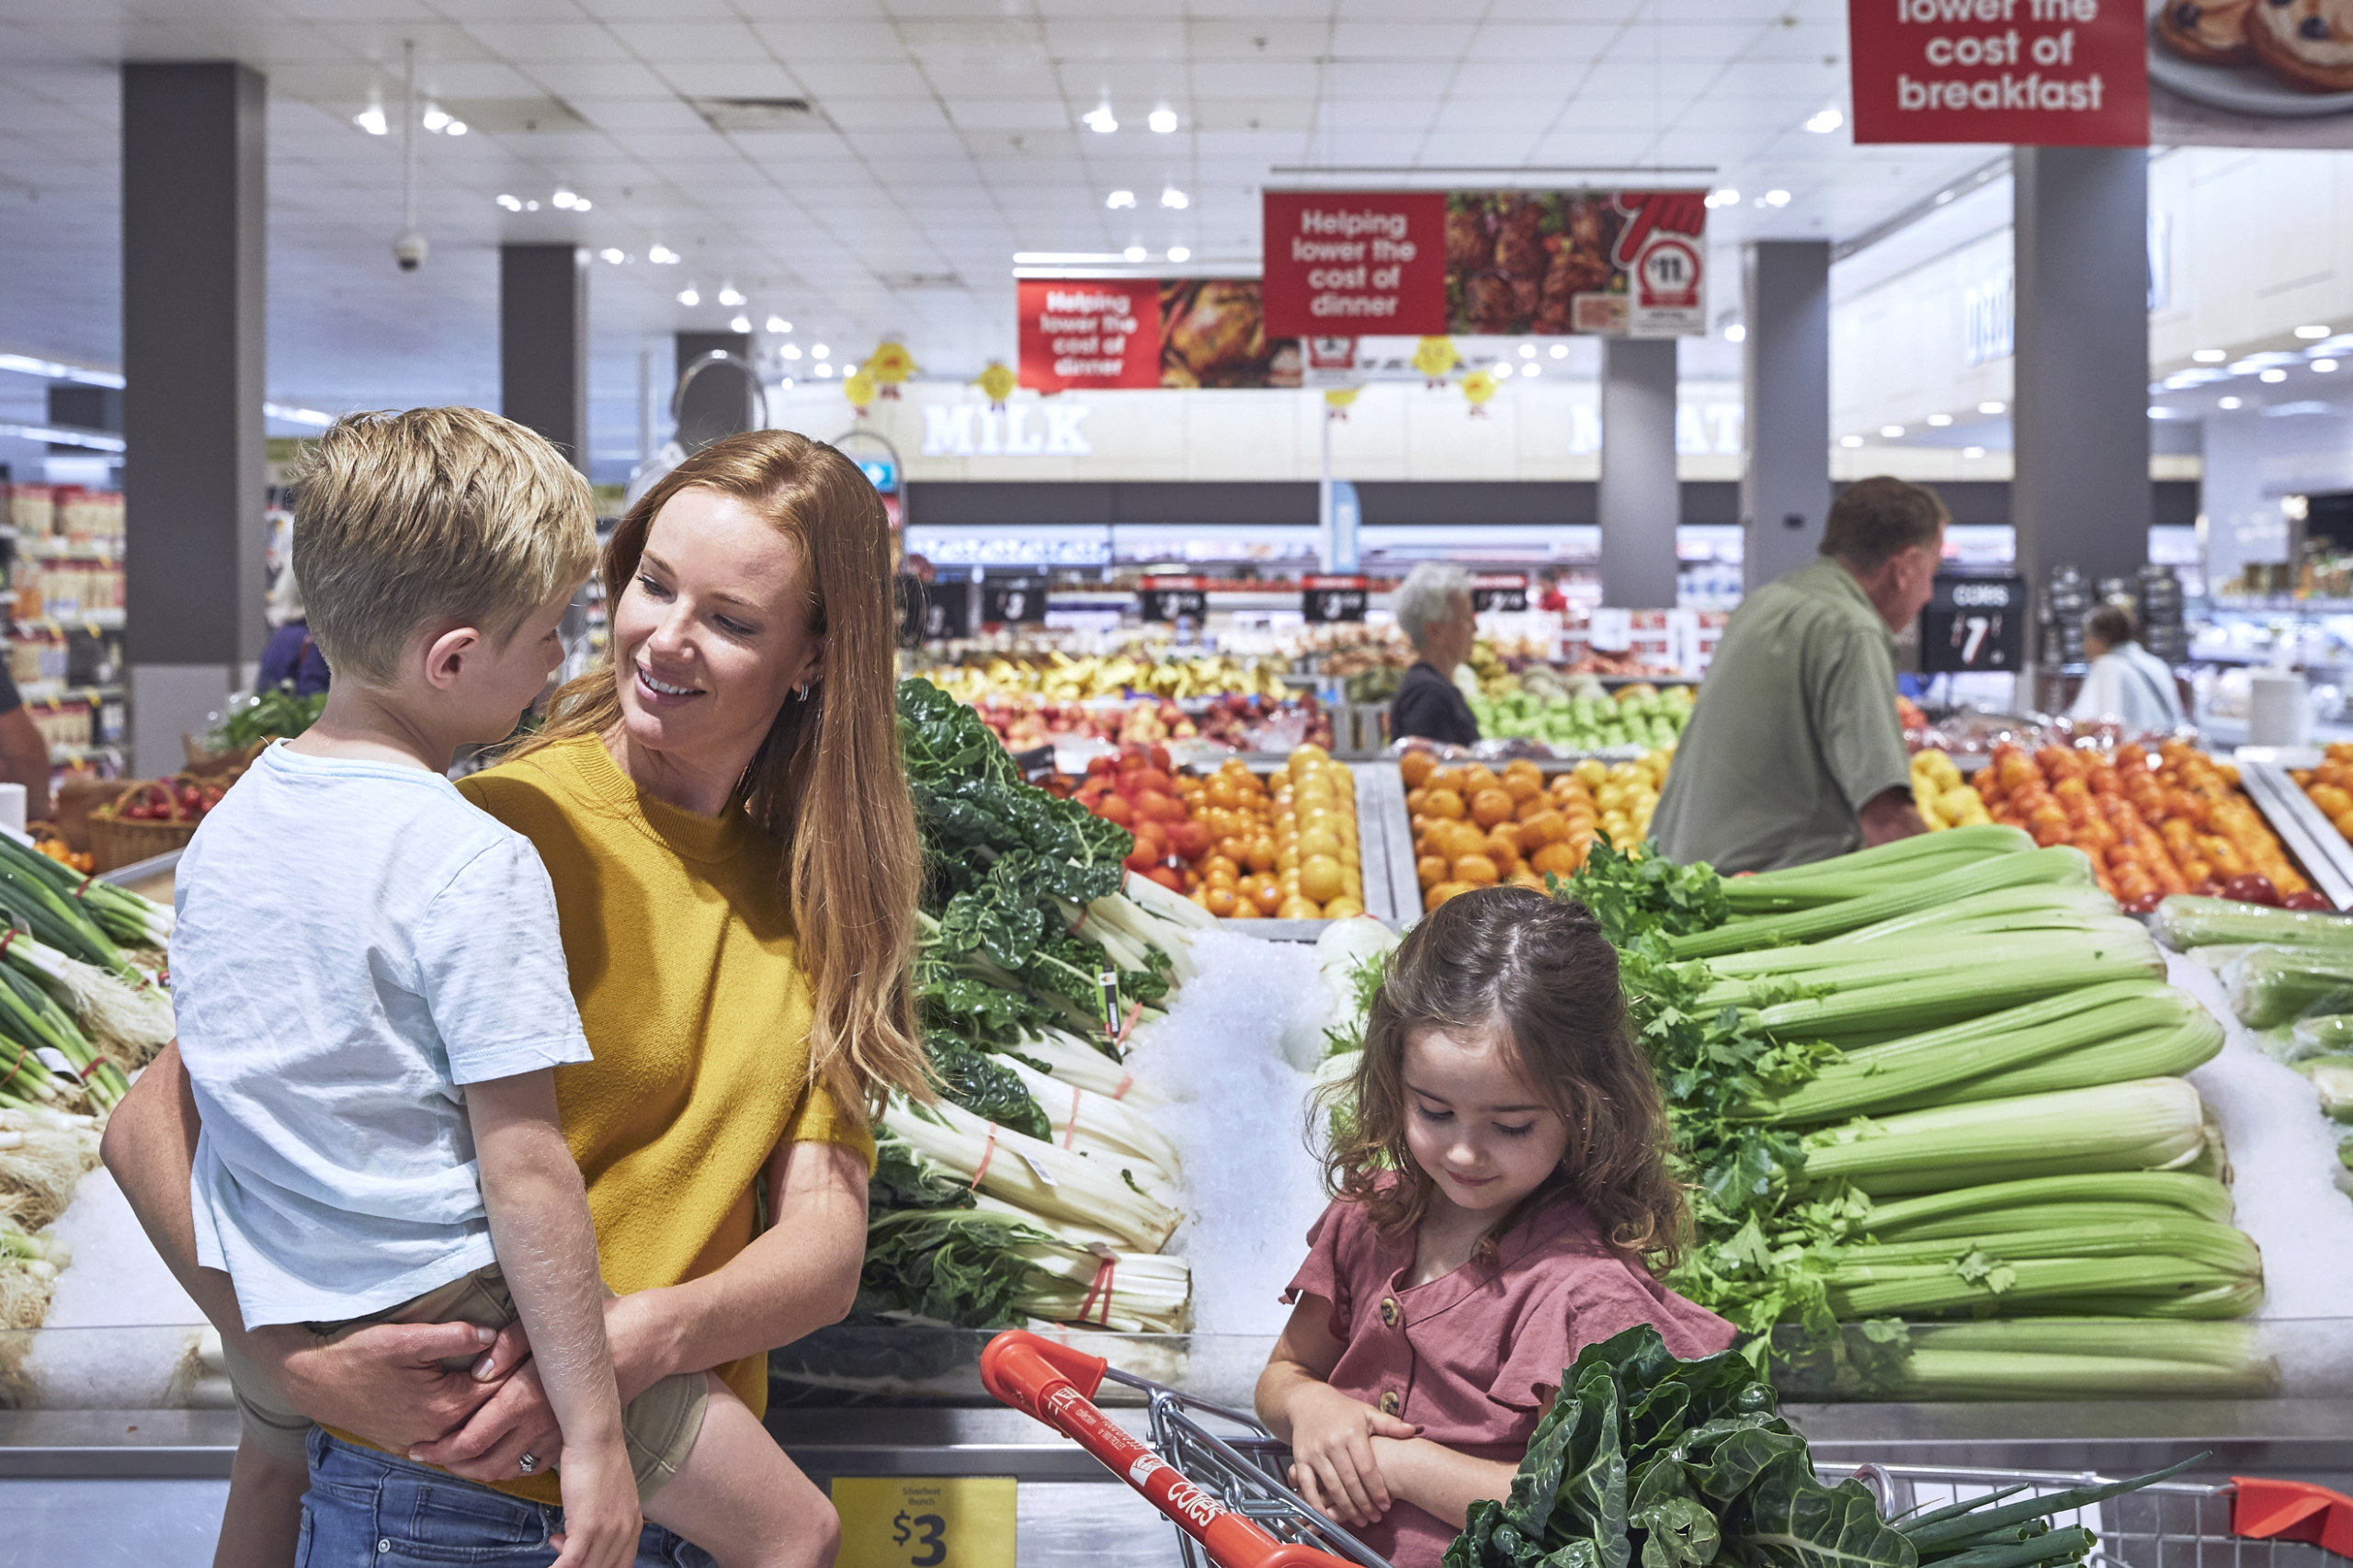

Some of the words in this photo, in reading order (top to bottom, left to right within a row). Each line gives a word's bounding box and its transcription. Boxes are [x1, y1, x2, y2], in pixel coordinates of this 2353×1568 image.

[1925, 29, 2021, 67] cost
[2030, 28, 2075, 67] of
[1897, 73, 2103, 110] breakfast
[1301, 208, 1408, 239] Helping
[1291, 237, 1367, 264] lower
[1370, 237, 1416, 263] the
[1307, 266, 1367, 290] cost
[1370, 265, 1402, 290] of
[1046, 290, 1131, 317] Helping
[1310, 291, 1399, 318] dinner
[922, 403, 1092, 457] MILK
[1566, 403, 1745, 457] MAT
[902, 1486, 941, 1497] Silverbeet
[1167, 1481, 1227, 1528] coles
[892, 1508, 948, 1567] $3
